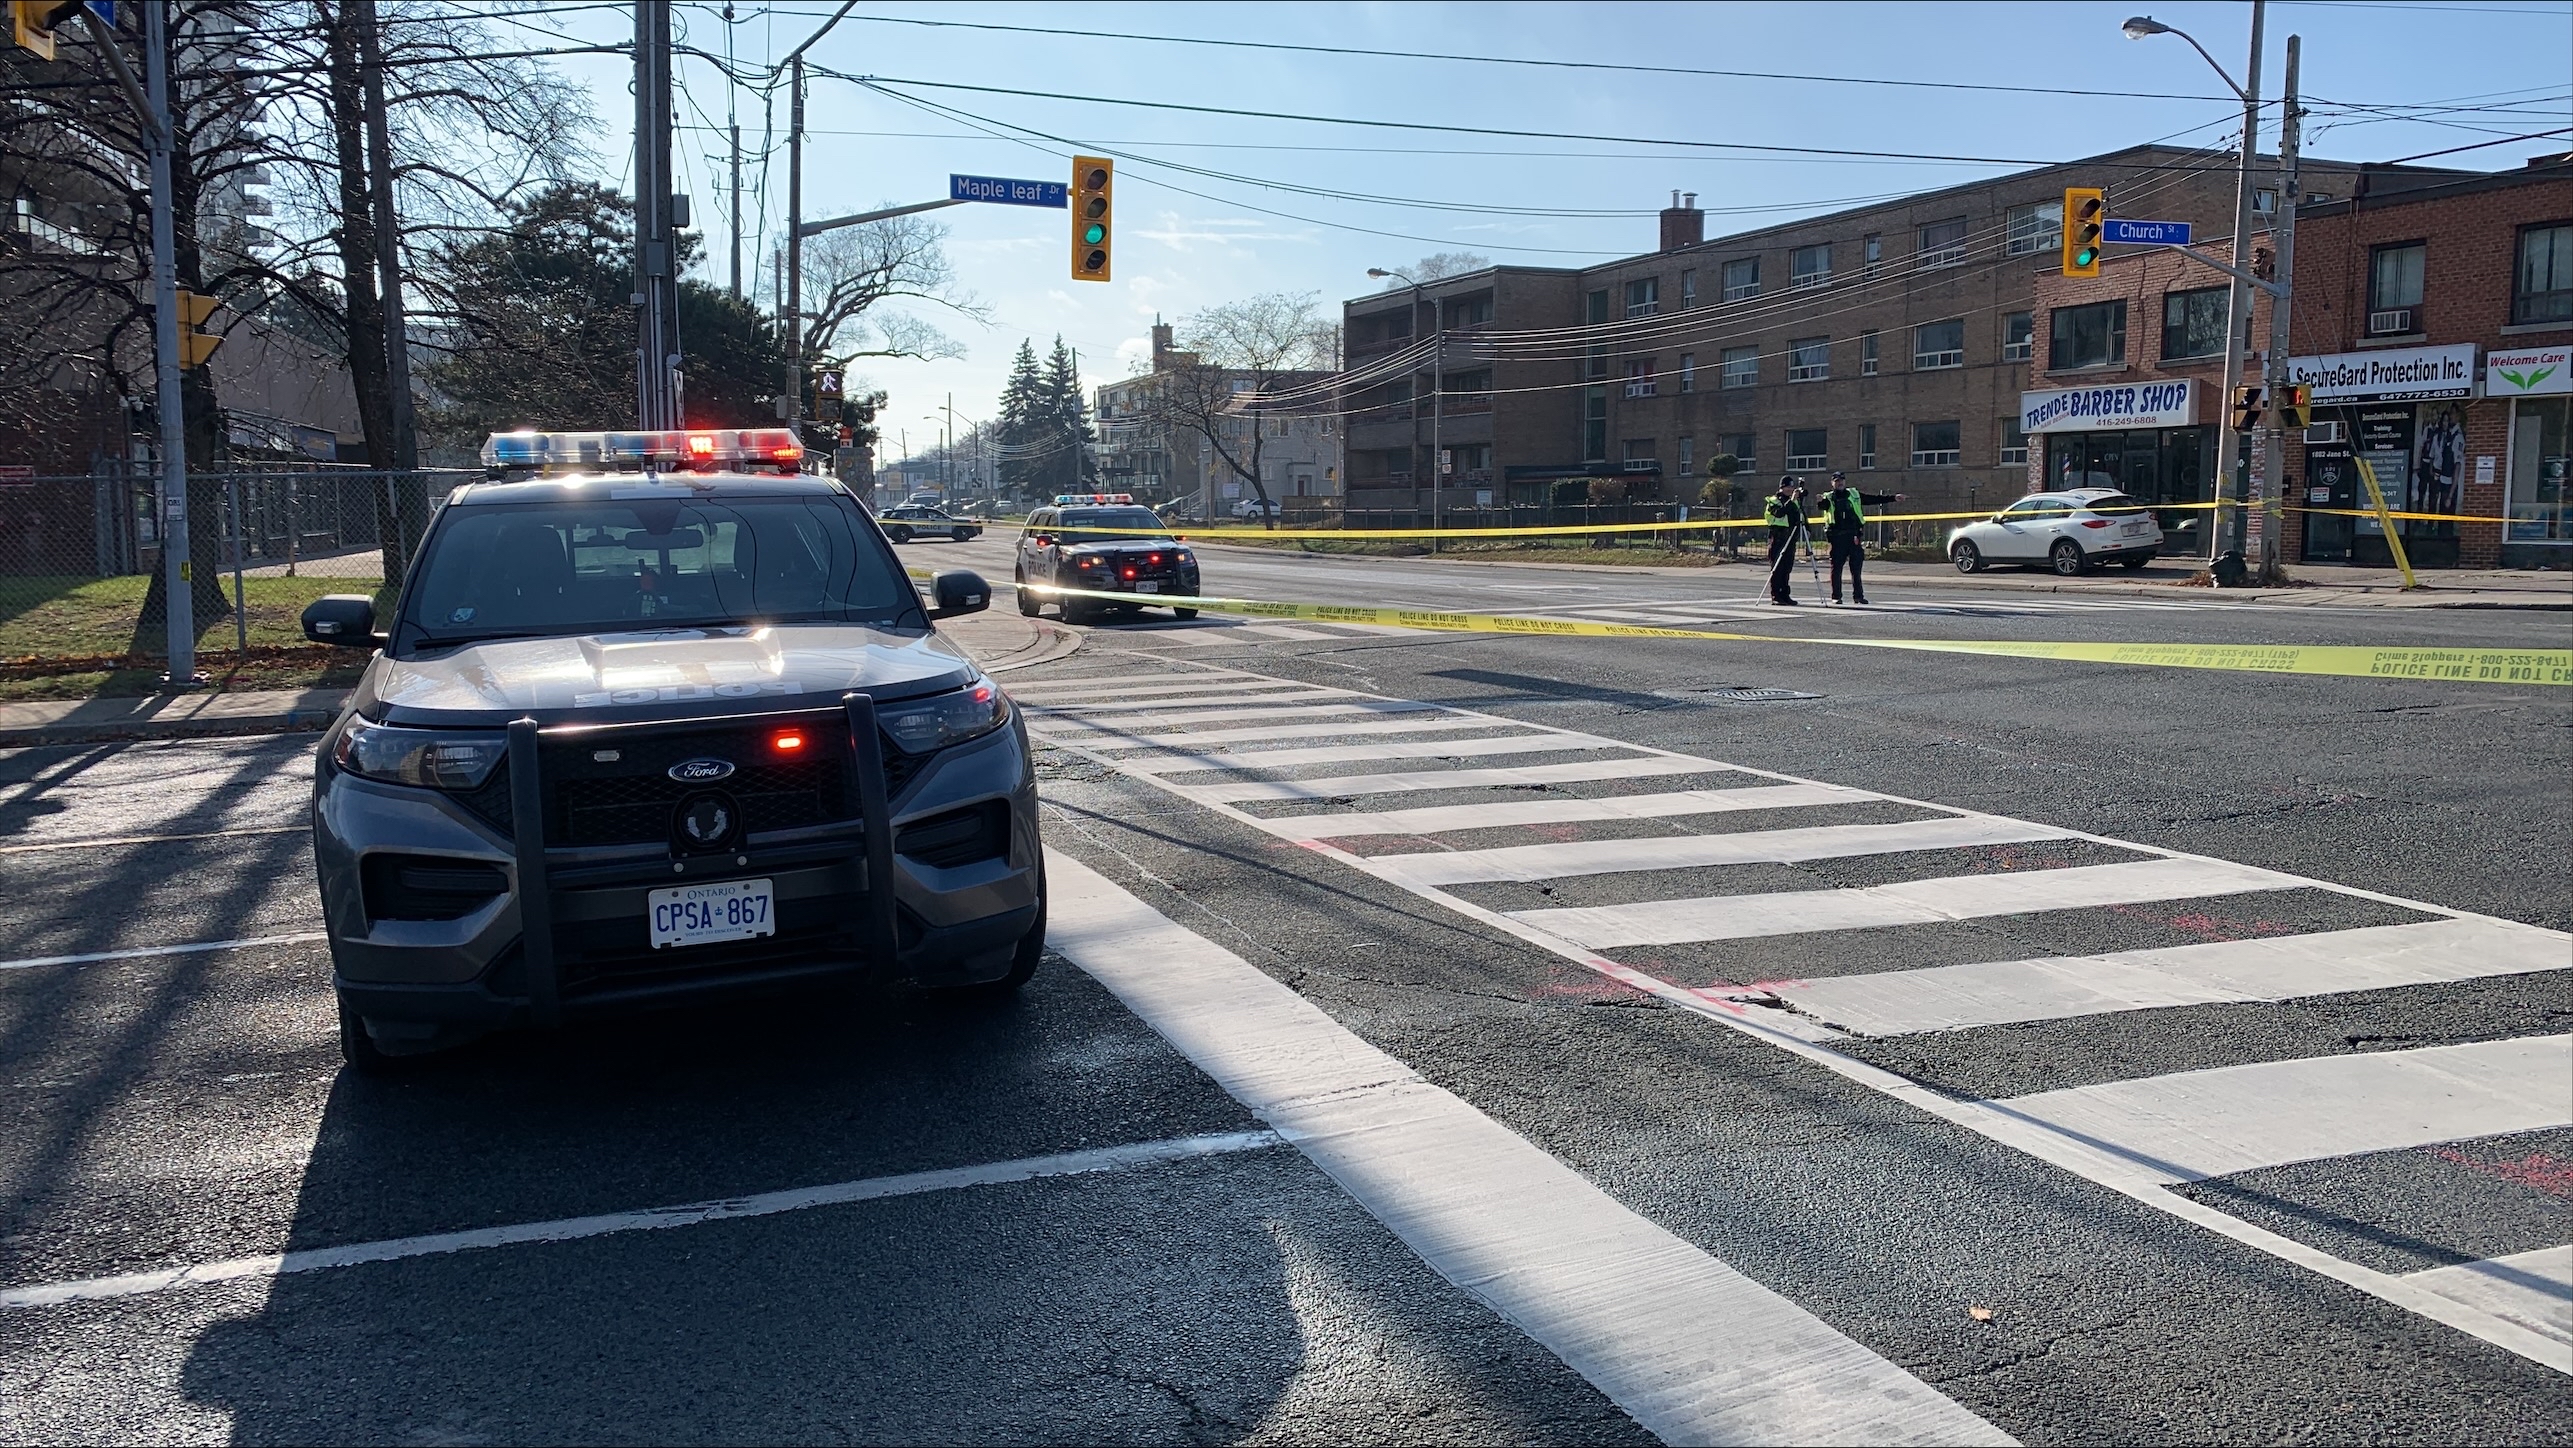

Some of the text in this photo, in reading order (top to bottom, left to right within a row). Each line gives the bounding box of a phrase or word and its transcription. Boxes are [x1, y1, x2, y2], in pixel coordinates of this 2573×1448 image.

[958, 178, 1004, 201] Maple
[1011, 181, 1042, 201] leaf
[2119, 223, 2175, 240] Church St
[2490, 353, 2565, 367] Welcome Care
[2296, 355, 2468, 388] SecureGard Protection Inc.
[2379, 388, 2465, 401] 647-772-6530
[2026, 383, 2188, 429] TRENDE BARBER SHOP
[2096, 416, 2157, 427] 416-249-6808
[1028, 559, 1047, 578] POLICE
[1399, 611, 1468, 623] POLICE LINE DO NOT CROSS
[1494, 618, 1514, 627] POLICE
[1515, 619, 1530, 628] LINE
[1530, 620, 1540, 629] DO
[1540, 621, 1553, 629] NOT
[1553, 622, 1575, 630] CROSS
[684, 762, 719, 777] Ford
[687, 887, 736, 900] ONTARIO
[656, 895, 768, 932] CPSA 867
